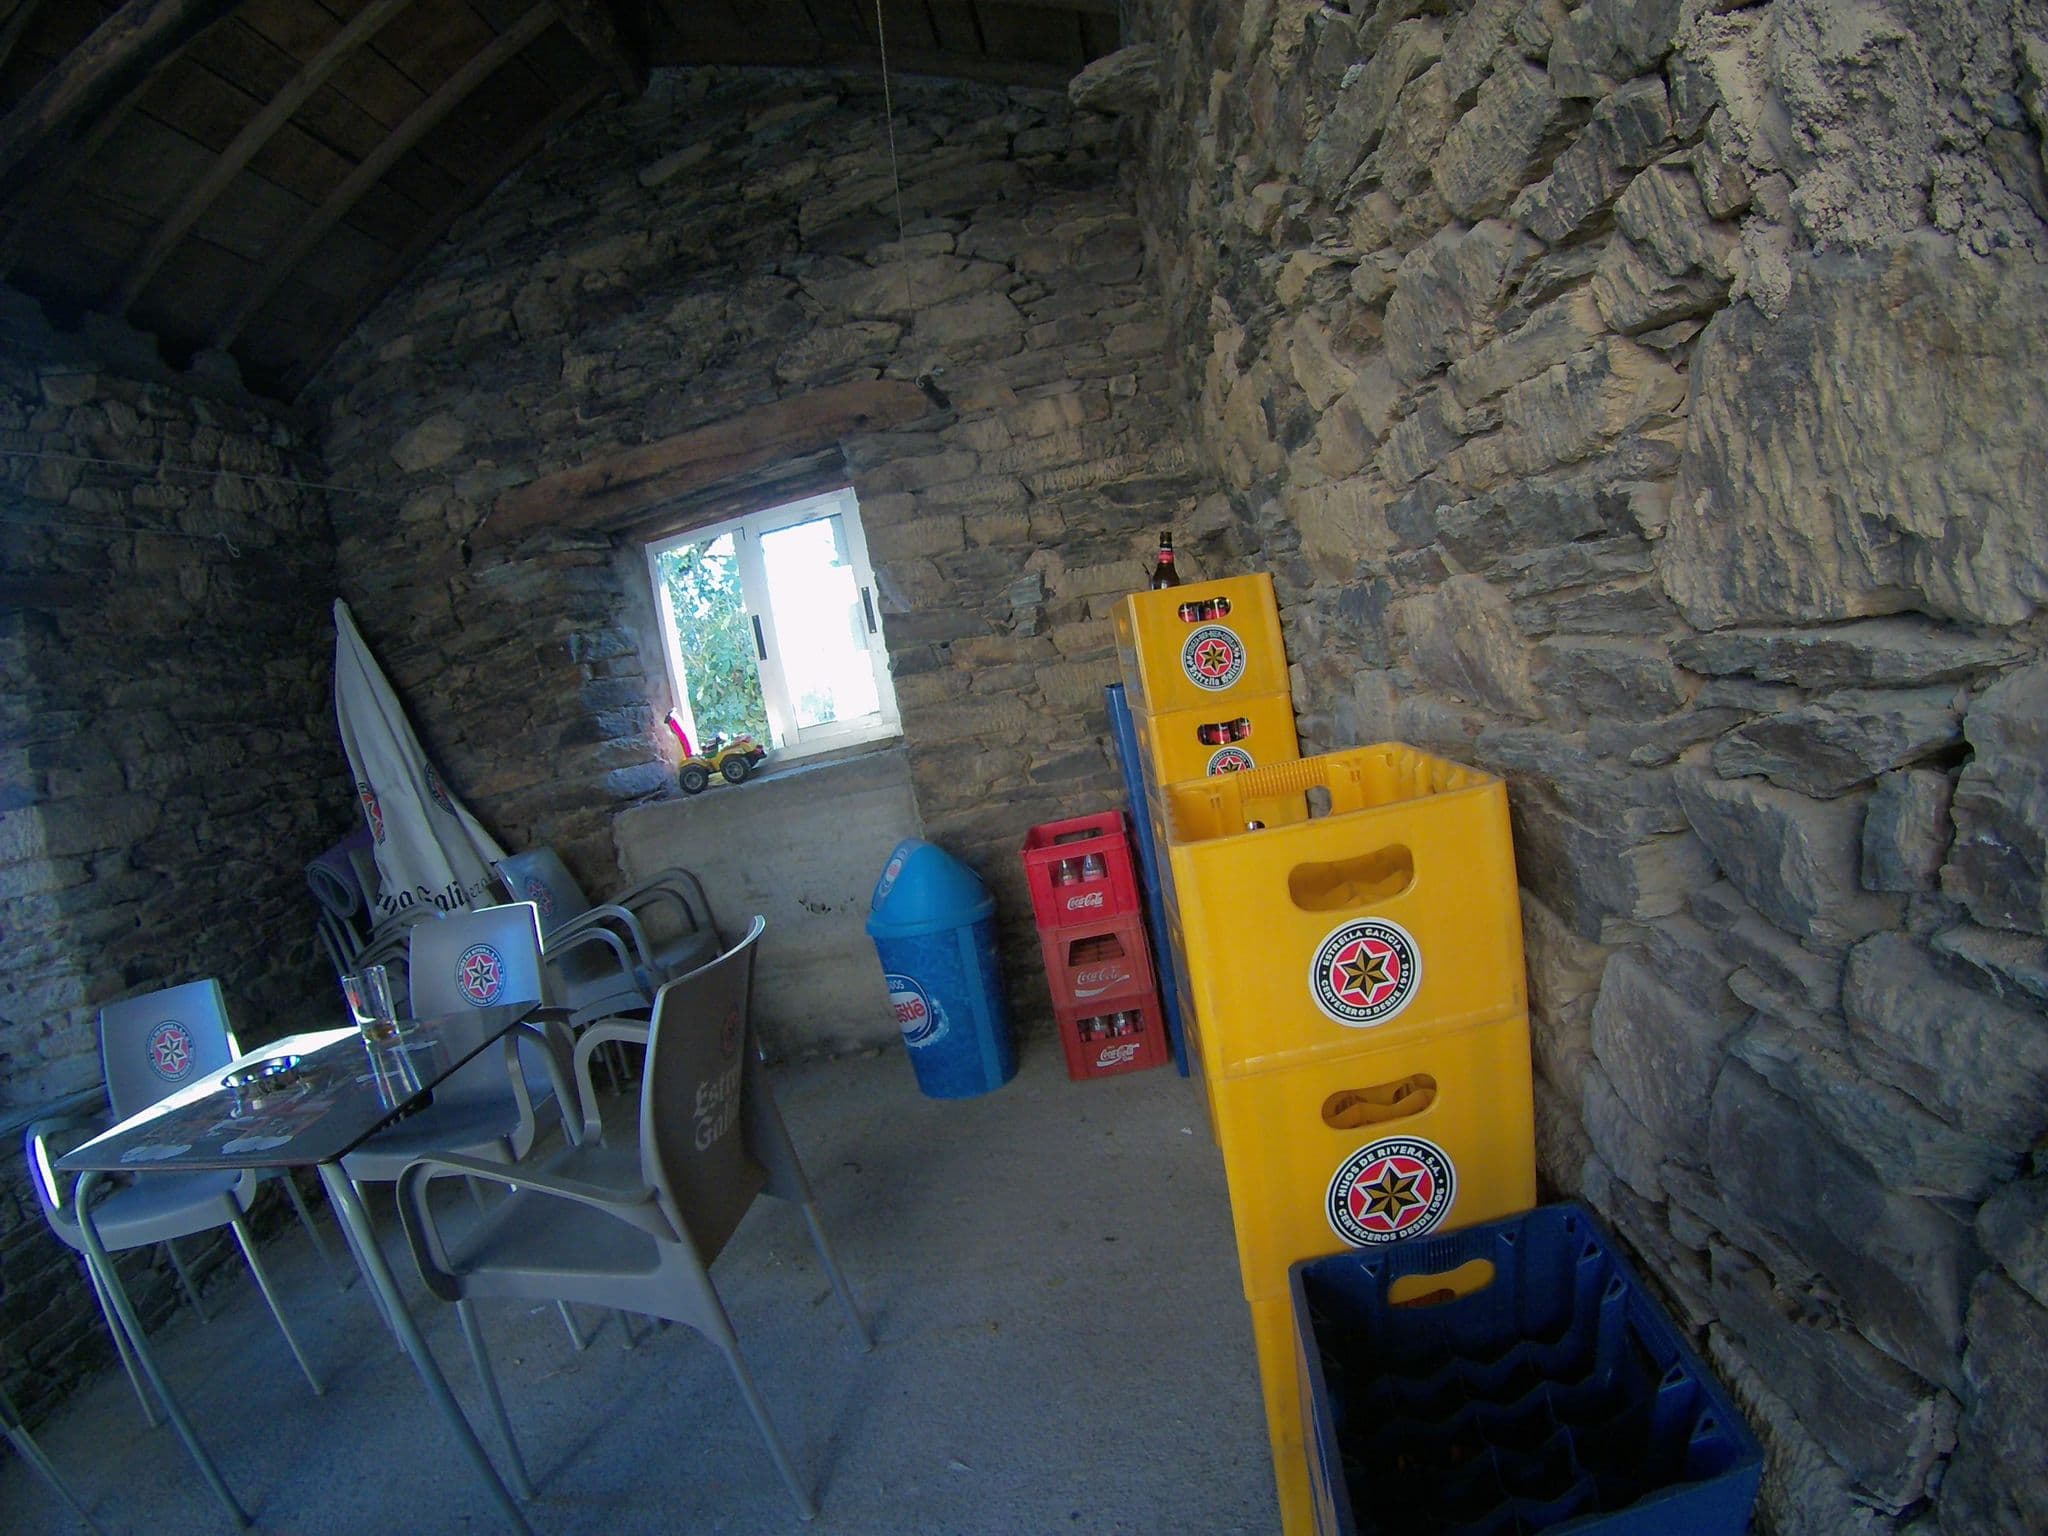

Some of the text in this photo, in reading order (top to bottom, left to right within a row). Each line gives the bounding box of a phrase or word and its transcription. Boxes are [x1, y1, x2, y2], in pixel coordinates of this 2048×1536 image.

[1066, 892, 1104, 911] Coca-Cola
[1322, 928, 1402, 966] ESTRELLA GALICIA
[1321, 963, 1410, 1017] CERVECEROS DESDE 1906
[1337, 1145, 1442, 1197] HIJOS DE RIVERA, S.A.
[1337, 1187, 1445, 1242] CERVECEROS DESDE 1906
